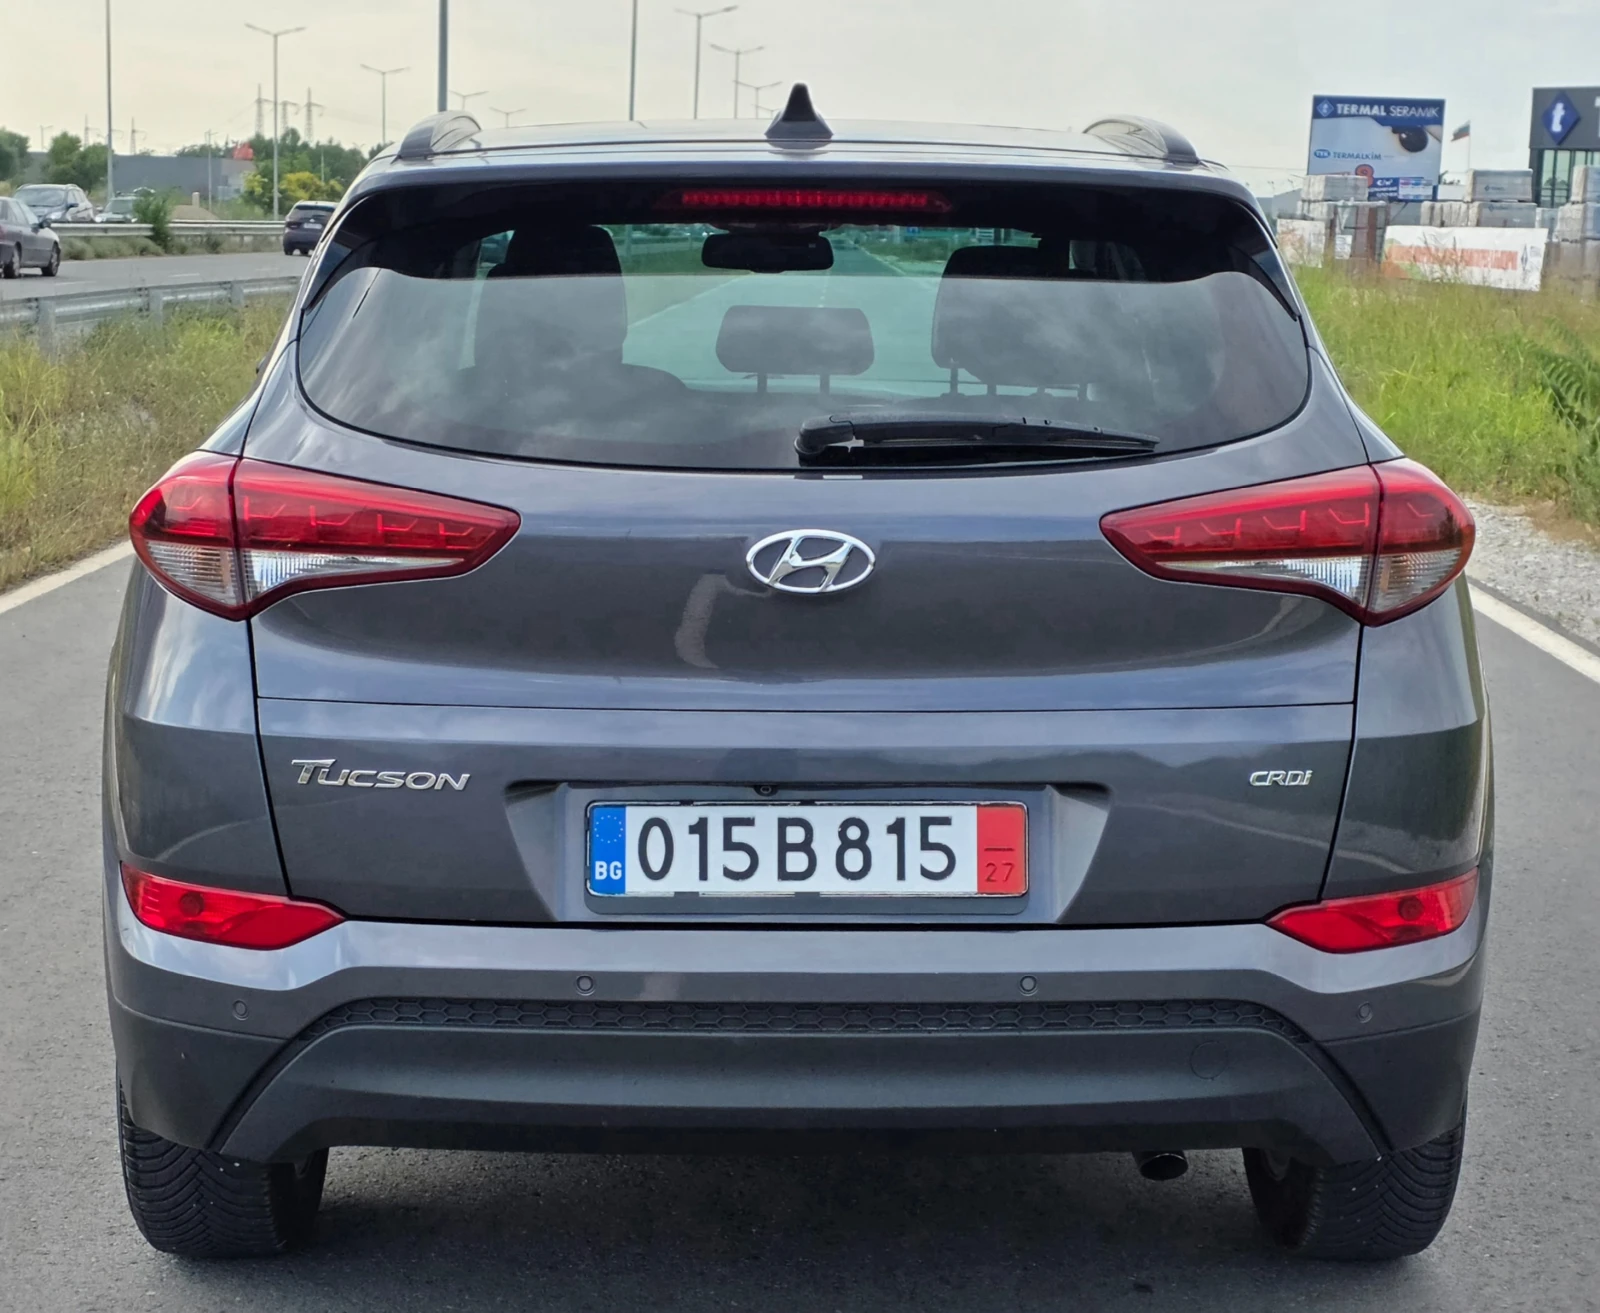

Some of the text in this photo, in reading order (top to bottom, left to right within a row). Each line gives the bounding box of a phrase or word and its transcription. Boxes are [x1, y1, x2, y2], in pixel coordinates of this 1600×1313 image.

[1336, 103, 1387, 115] TERMAL
[291, 758, 471, 791] TUCSON
[1249, 769, 1313, 786] CRDi
[594, 861, 622, 880] BG
[984, 862, 1015, 883] 27
